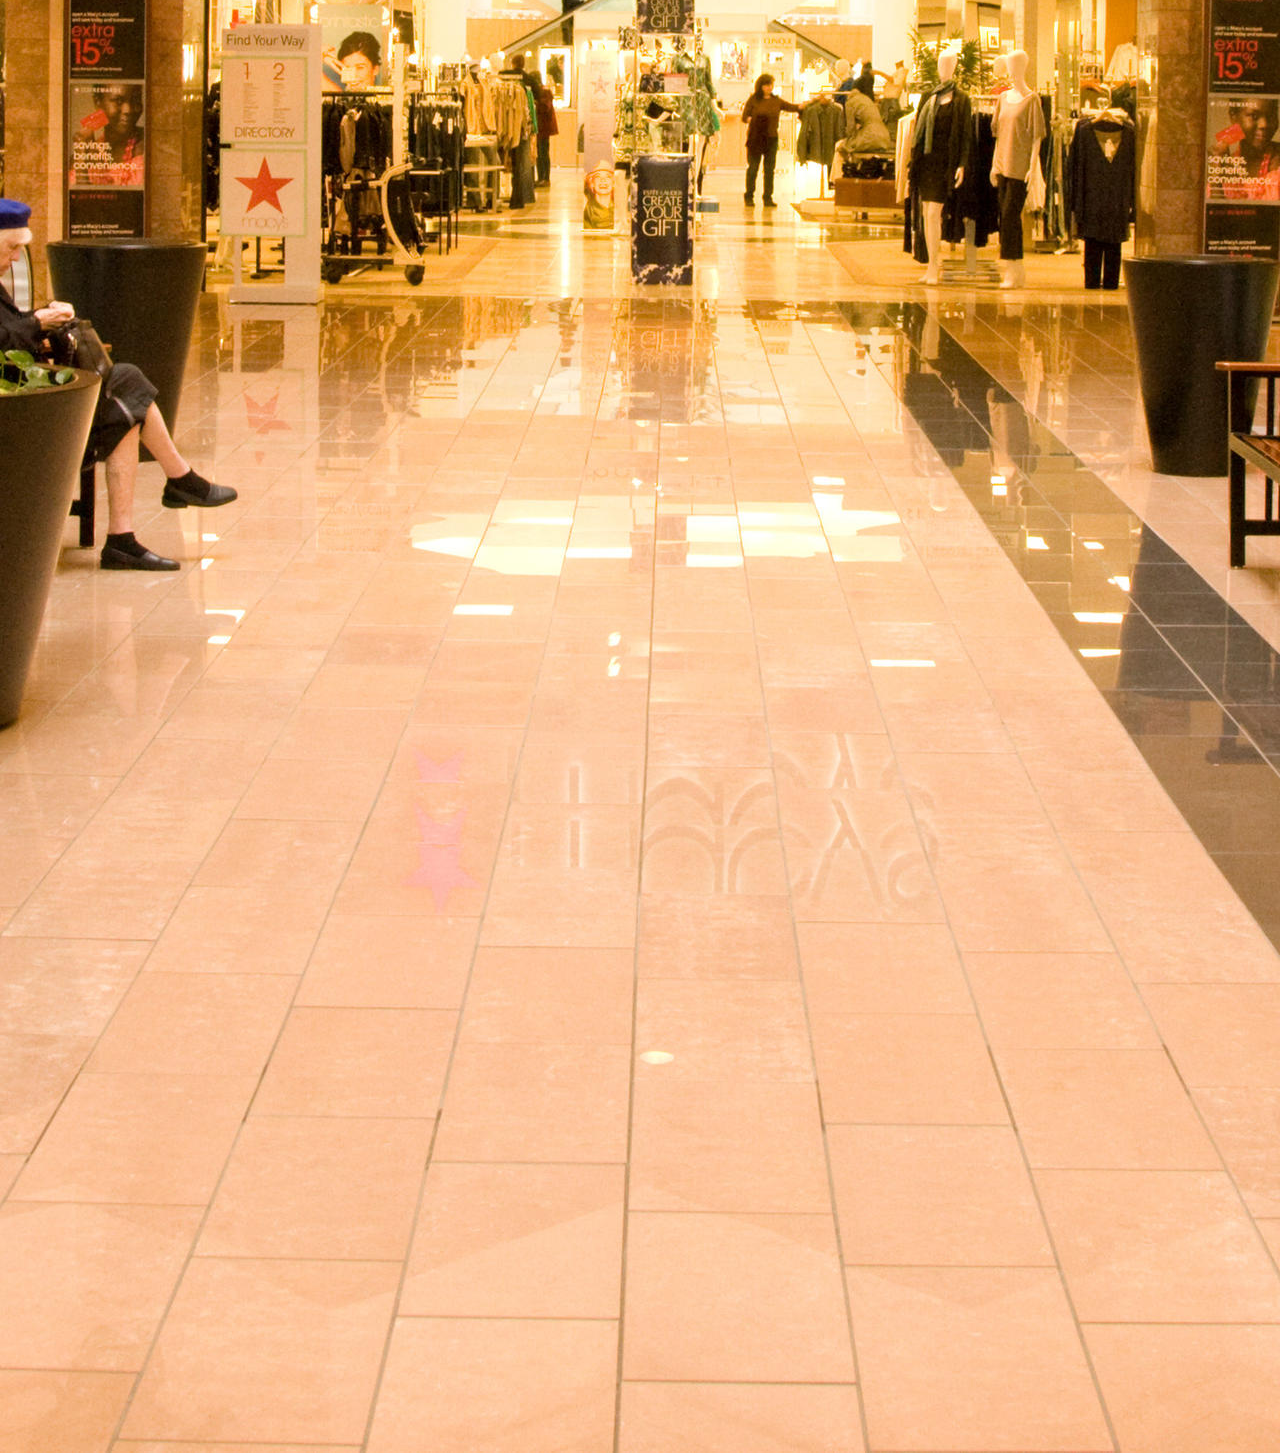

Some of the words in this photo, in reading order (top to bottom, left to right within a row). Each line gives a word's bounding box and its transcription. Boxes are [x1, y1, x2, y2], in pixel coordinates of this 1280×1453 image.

[650, 6, 681, 17] YOUR
[649, 16, 680, 29] GIFT
[71, 24, 115, 38] extra
[226, 33, 251, 46] Find
[253, 33, 278, 46] Your
[281, 34, 305, 49] Way
[1214, 38, 1259, 52] extra
[71, 38, 115, 65] 15%
[273, 62, 286, 81] 2
[1214, 52, 1258, 79] 15%
[234, 126, 296, 139] DIRECTORY
[73, 140, 112, 151] savings,
[73, 151, 115, 162] benefits,
[1207, 154, 1248, 166] savings,
[1207, 165, 1249, 176] benefits,
[642, 195, 683, 207] CREATE
[642, 206, 683, 219] YOUR
[241, 215, 288, 231] macy's
[641, 218, 684, 237] GIFT
